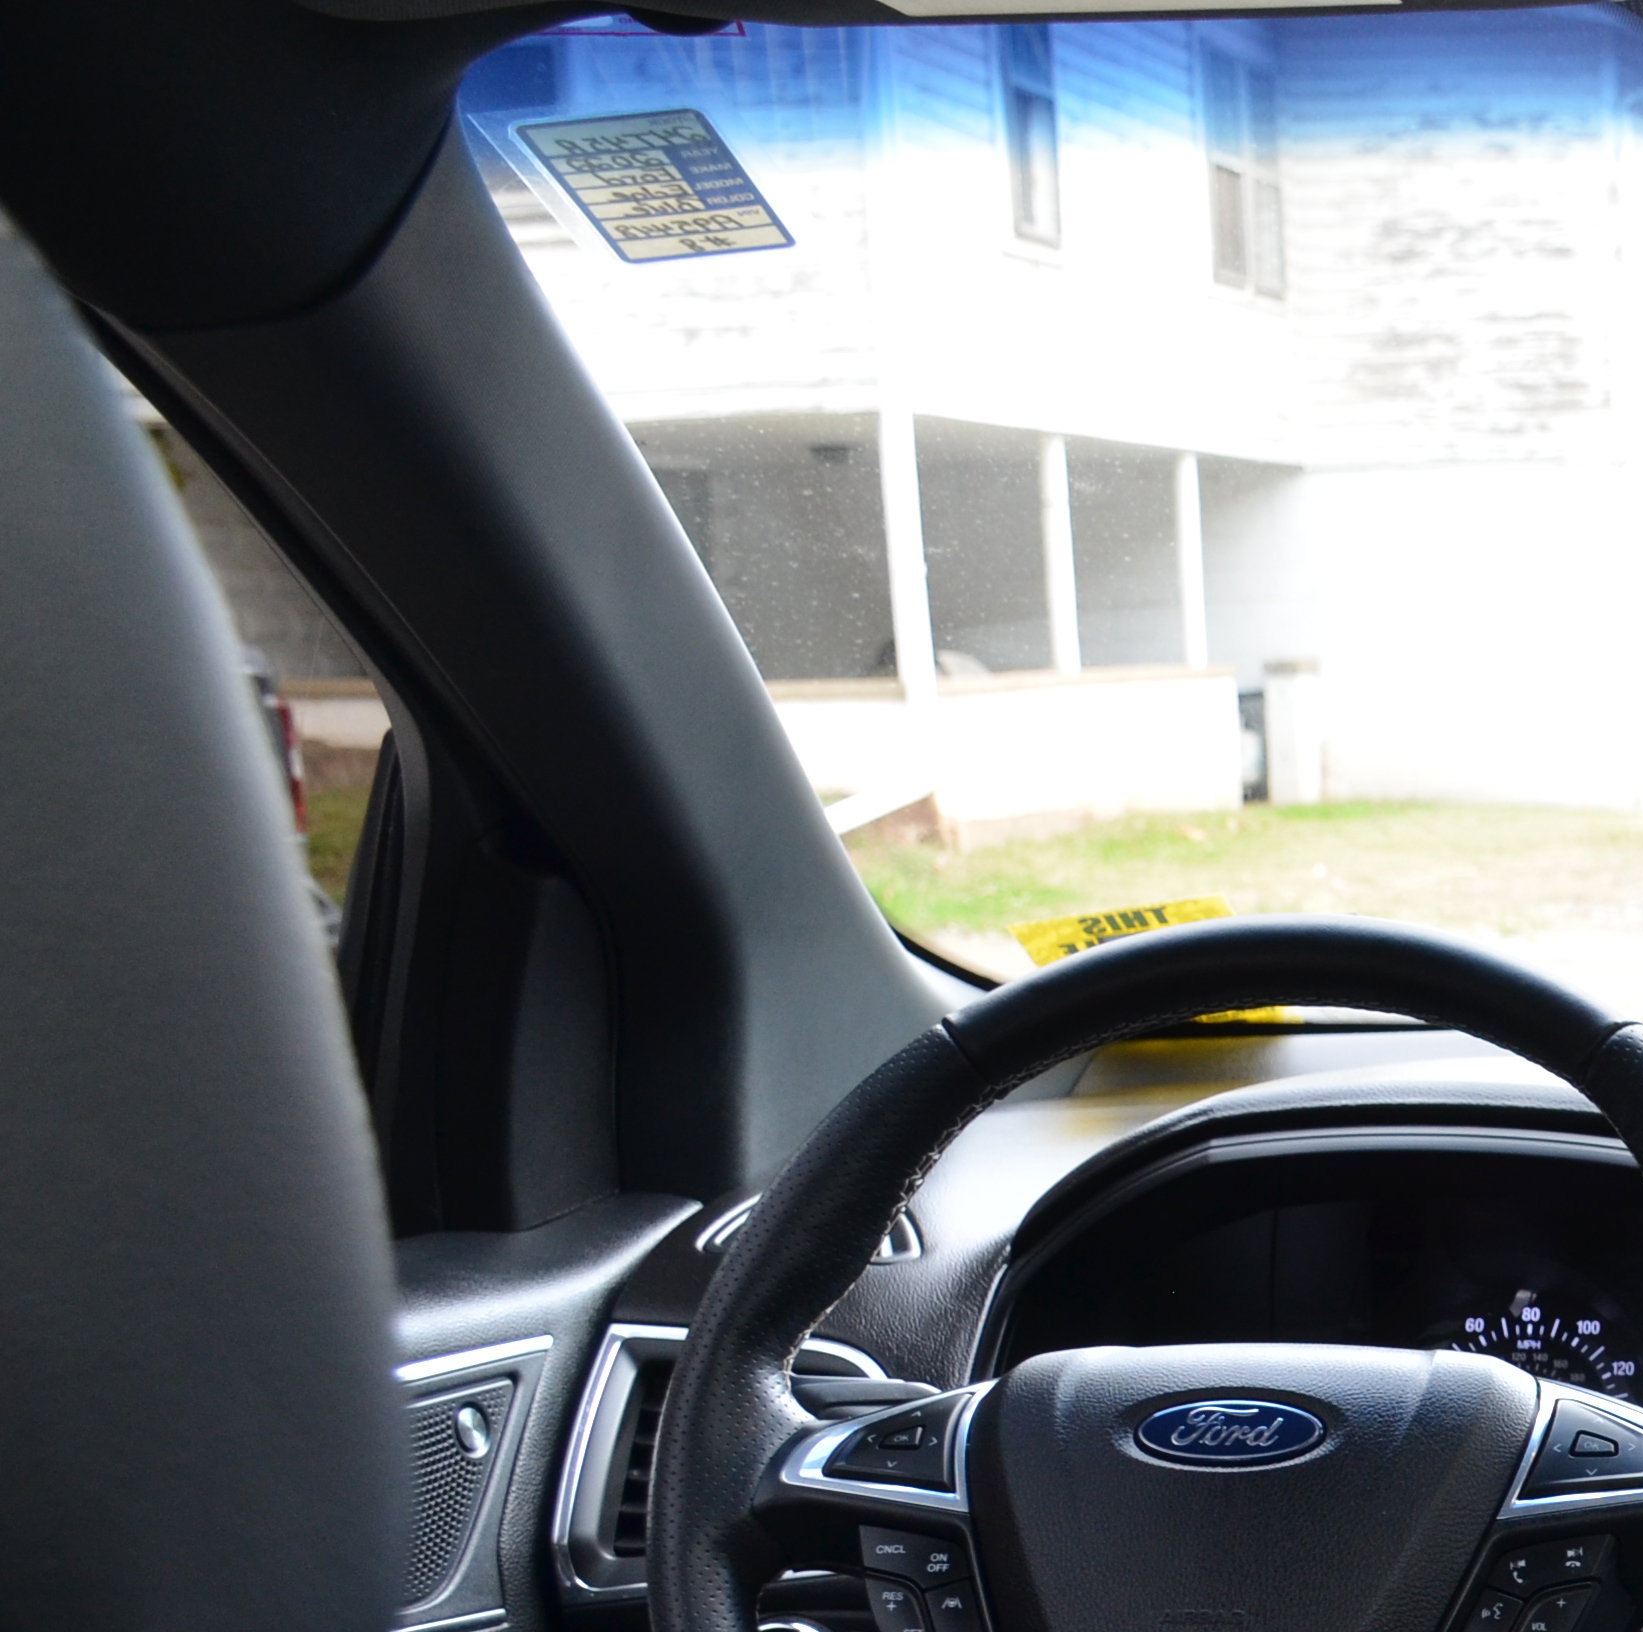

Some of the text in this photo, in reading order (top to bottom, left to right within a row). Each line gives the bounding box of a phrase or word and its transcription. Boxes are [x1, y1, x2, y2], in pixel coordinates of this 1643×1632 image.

[1521, 1306, 1541, 1322] 80
[1465, 1317, 1485, 1333] 60
[1576, 1320, 1601, 1335] 100
[1516, 1340, 1541, 1350] MPH
[1612, 1361, 1635, 1376] 120
[1171, 1405, 1284, 1447] Ford
[875, 1544, 906, 1555] CNCL
[930, 1553, 948, 1562] ON
[927, 1563, 950, 1573] OFF
[882, 1591, 904, 1601] RES
[1531, 1621, 1548, 1632] VOL
